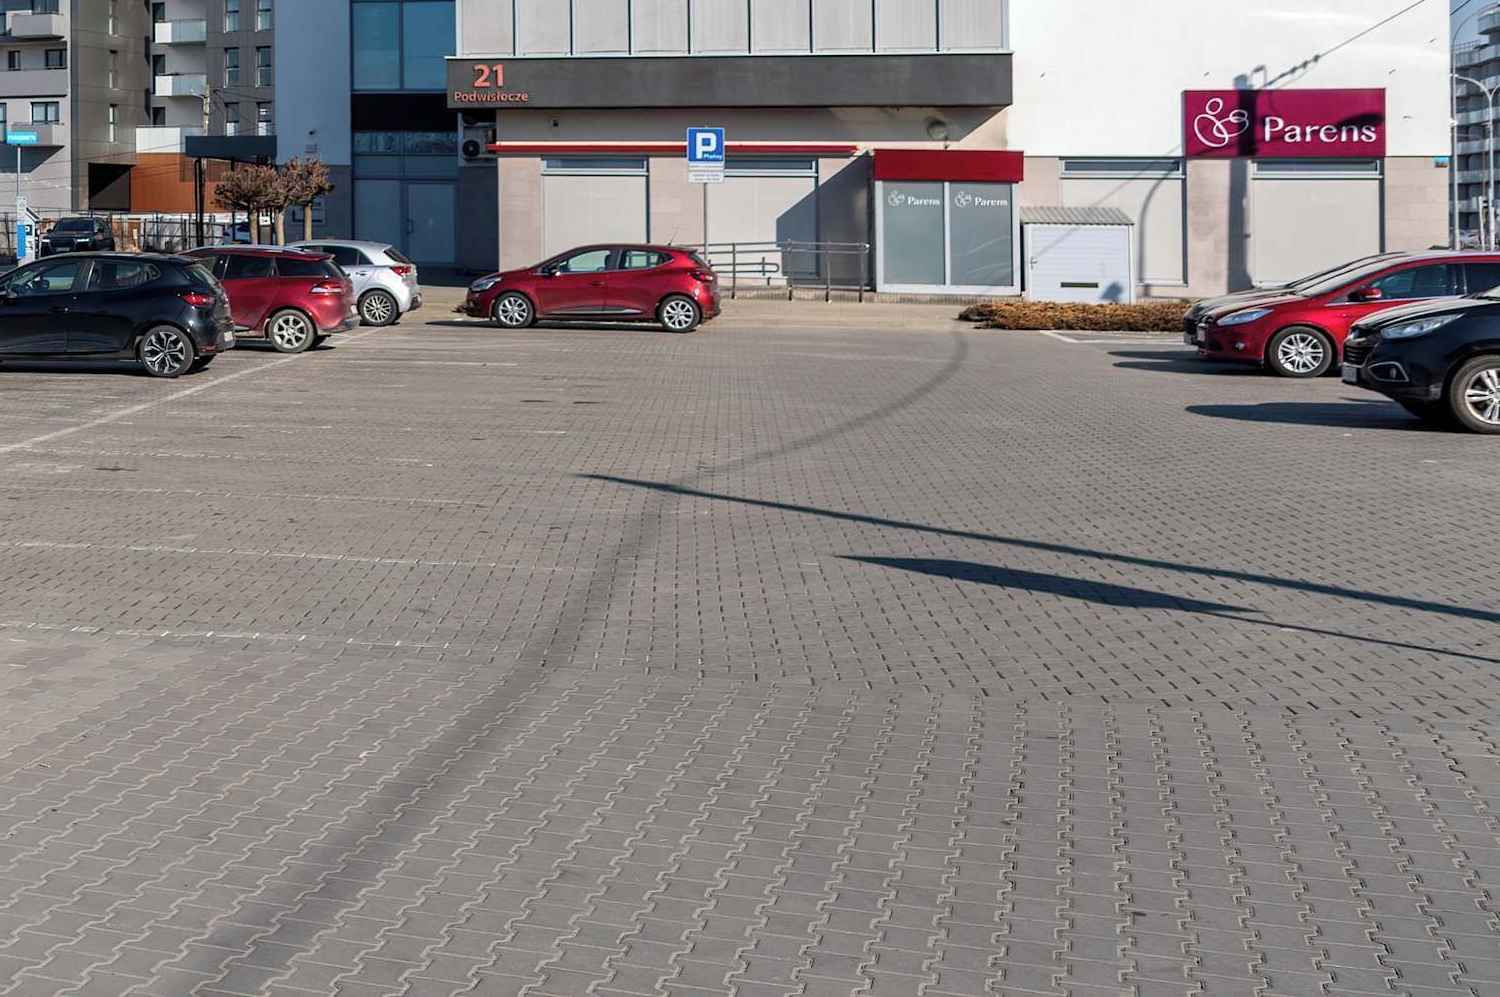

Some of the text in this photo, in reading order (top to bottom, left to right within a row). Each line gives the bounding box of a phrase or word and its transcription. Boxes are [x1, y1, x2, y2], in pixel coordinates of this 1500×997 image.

[473, 64, 504, 87] 21
[1264, 116, 1377, 143] Parens
[696, 132, 717, 159] P
[907, 195, 941, 206] Parens
[974, 196, 1009, 207] Parens
